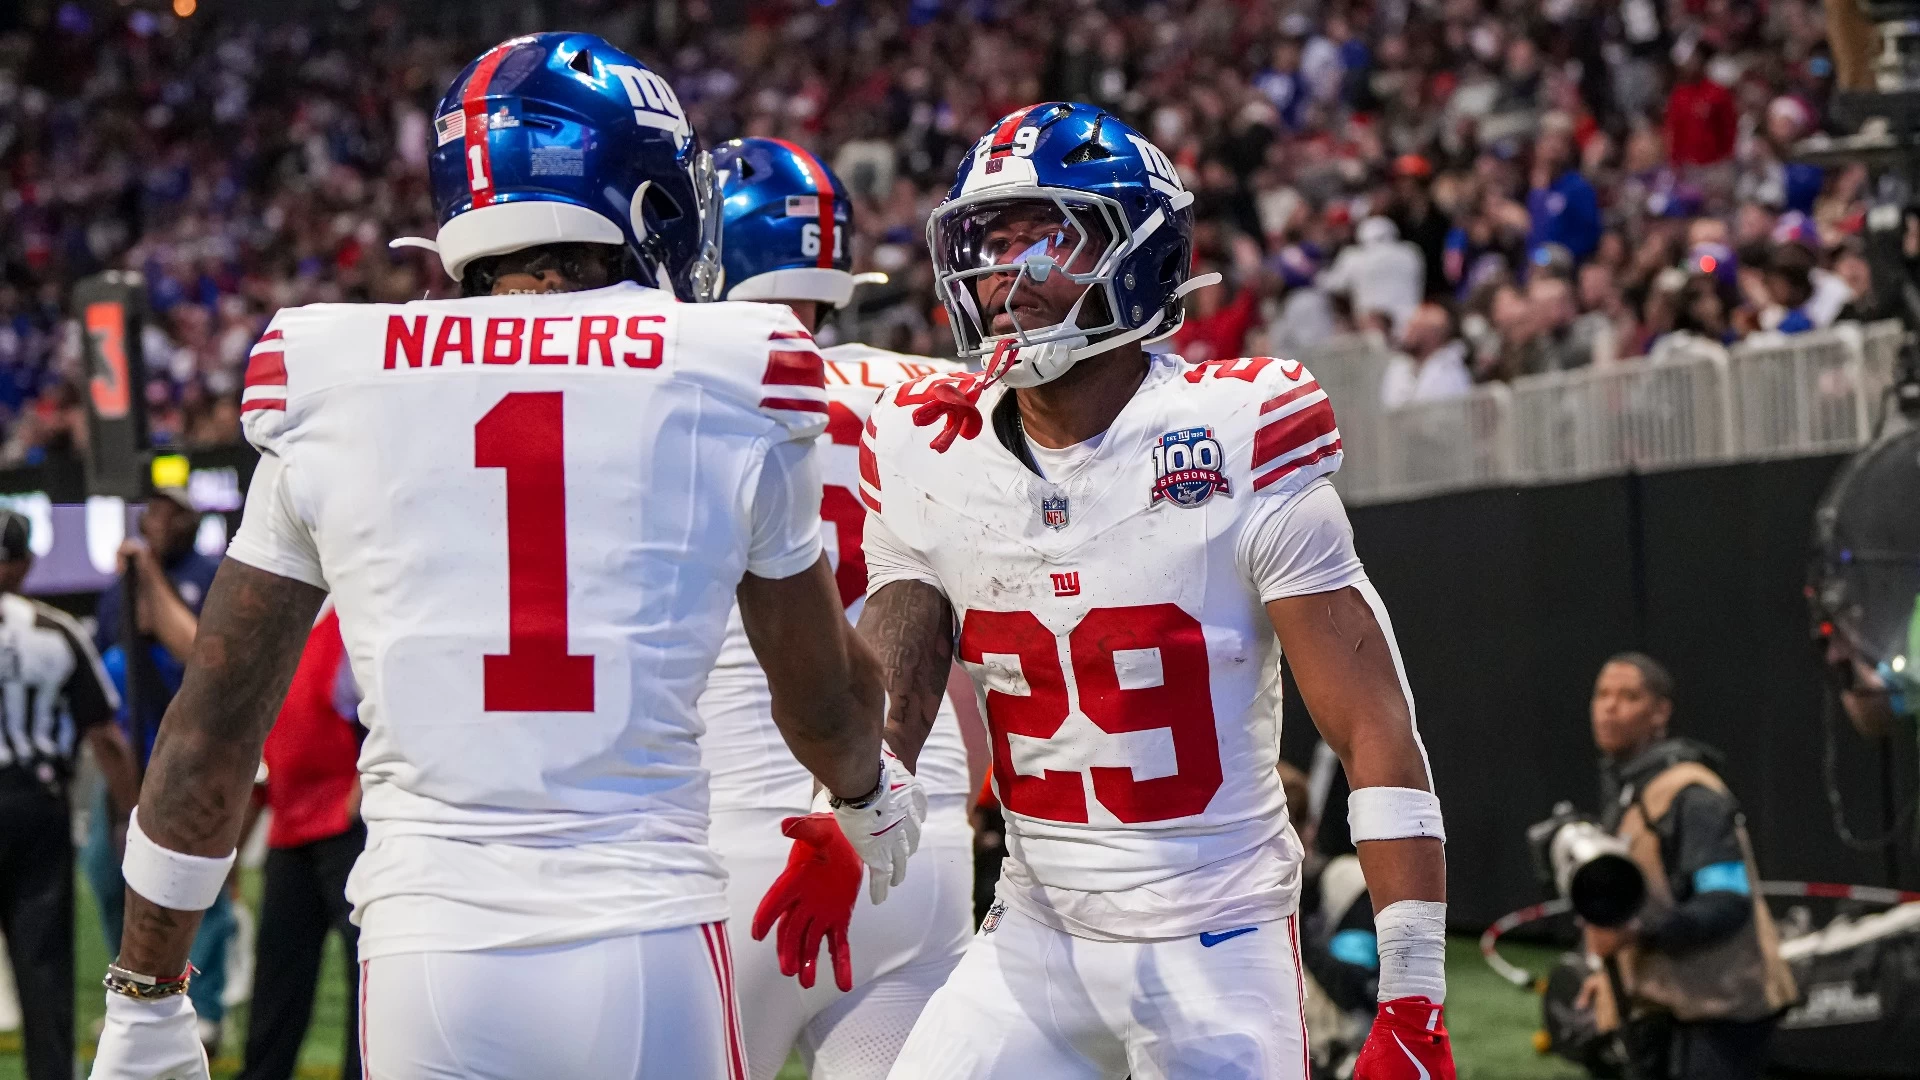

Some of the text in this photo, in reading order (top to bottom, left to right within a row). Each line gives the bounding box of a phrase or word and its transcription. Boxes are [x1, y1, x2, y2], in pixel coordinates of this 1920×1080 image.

[468, 144, 489, 190] 1
[801, 223, 843, 259] 61
[383, 315, 666, 370] NABERS
[1152, 439, 1222, 480] 100
[1160, 471, 1216, 487] SEASONS
[1045, 510, 1065, 525] NFL
[474, 391, 595, 712] 1
[959, 602, 1224, 824] 29
